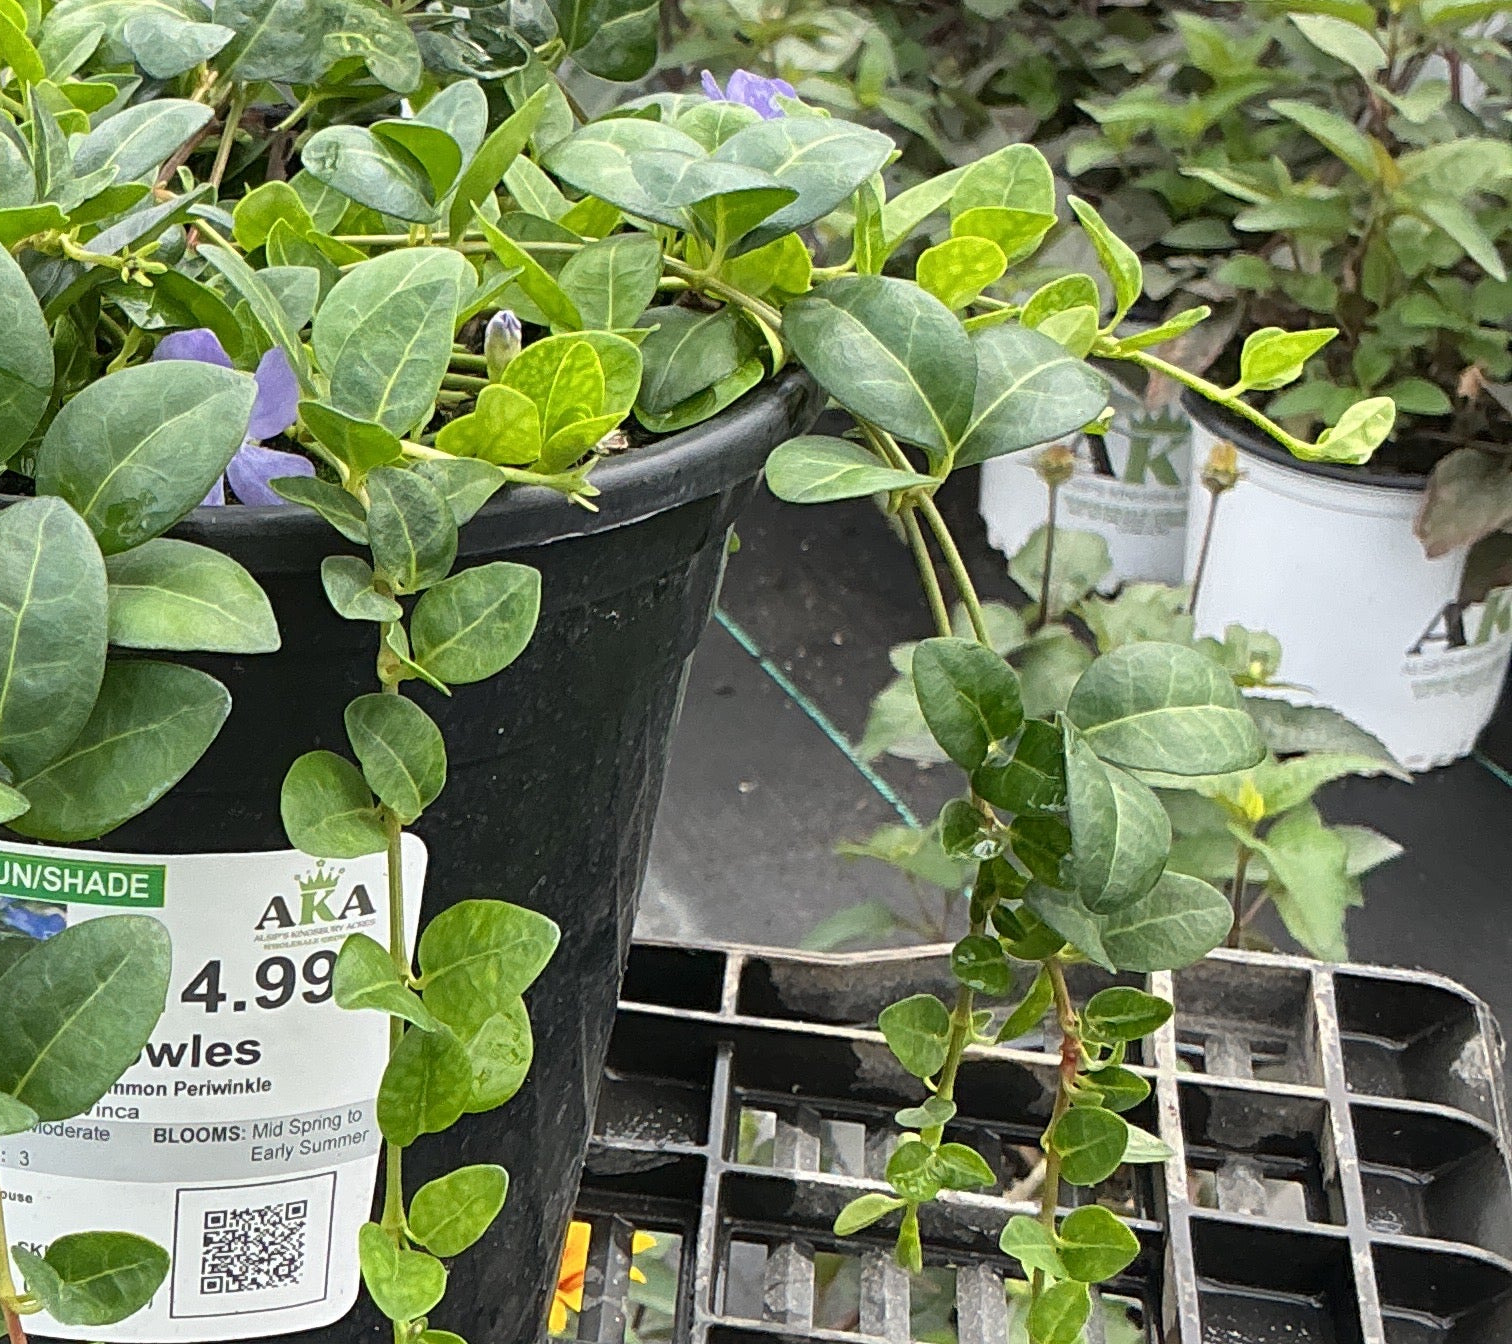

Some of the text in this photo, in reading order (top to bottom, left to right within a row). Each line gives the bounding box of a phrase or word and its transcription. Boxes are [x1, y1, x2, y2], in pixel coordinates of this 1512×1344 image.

[254, 884, 377, 930] AKA
[180, 949, 339, 1014] 4.99
[107, 1077, 272, 1097] mmon Periwinkle
[84, 1102, 140, 1120] inca
[153, 1108, 363, 1144] BLOOMS: Mid Spring to
[19, 1150, 30, 1167] 3
[251, 1129, 370, 1162] Early Summer
